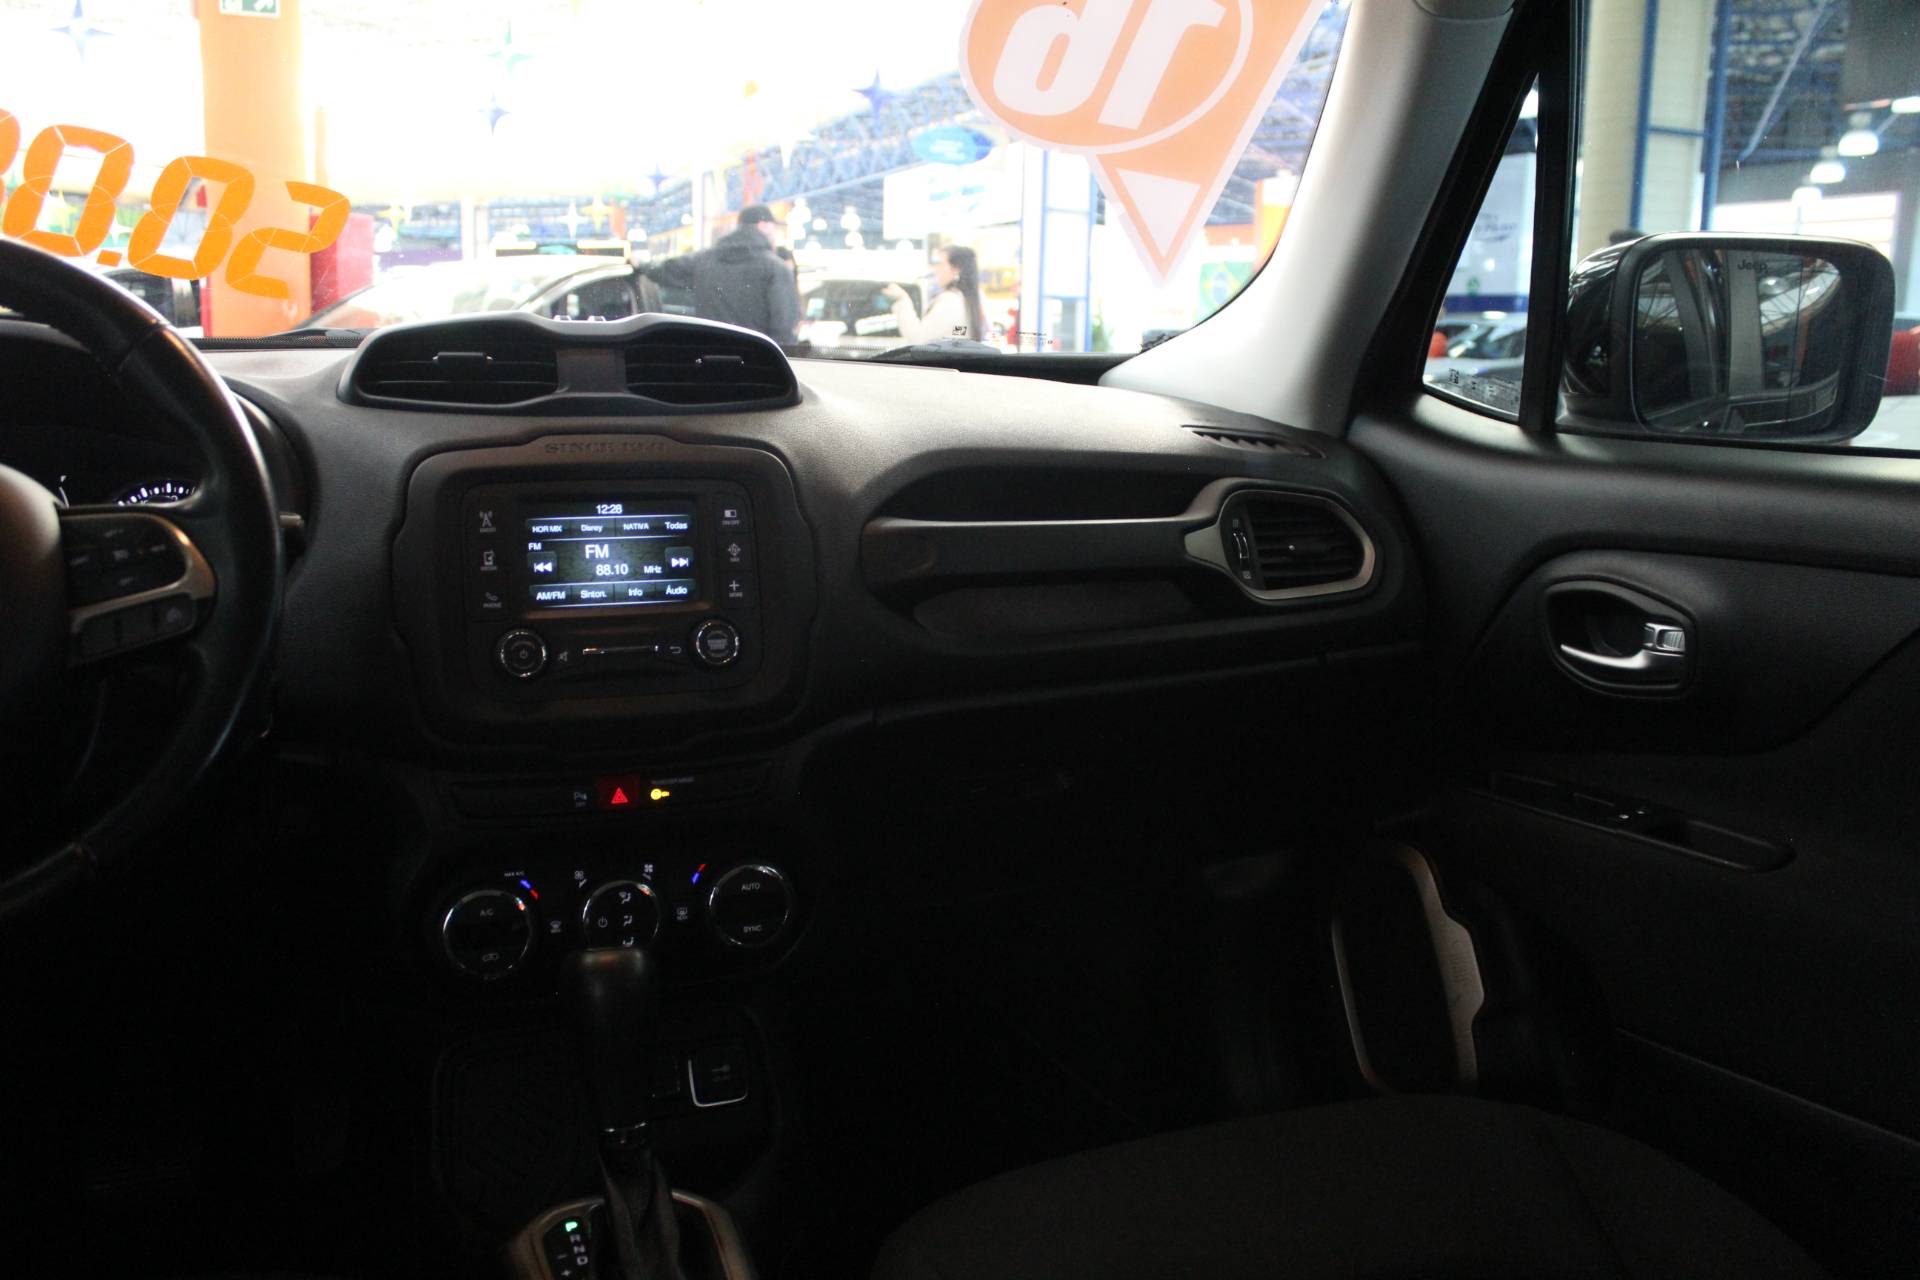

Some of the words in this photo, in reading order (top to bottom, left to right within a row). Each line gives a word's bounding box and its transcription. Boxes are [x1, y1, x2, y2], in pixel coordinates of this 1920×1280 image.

[1737, 259, 1768, 273] Jeep
[596, 504, 623, 514] 12:28
[528, 542, 542, 551] FM
[585, 544, 610, 559] FM
[595, 564, 629, 576] 88.10
[644, 565, 663, 574] MHz
[536, 591, 566, 600] AM/FM
[628, 587, 644, 597] Info
[741, 882, 761, 892] AUTO
